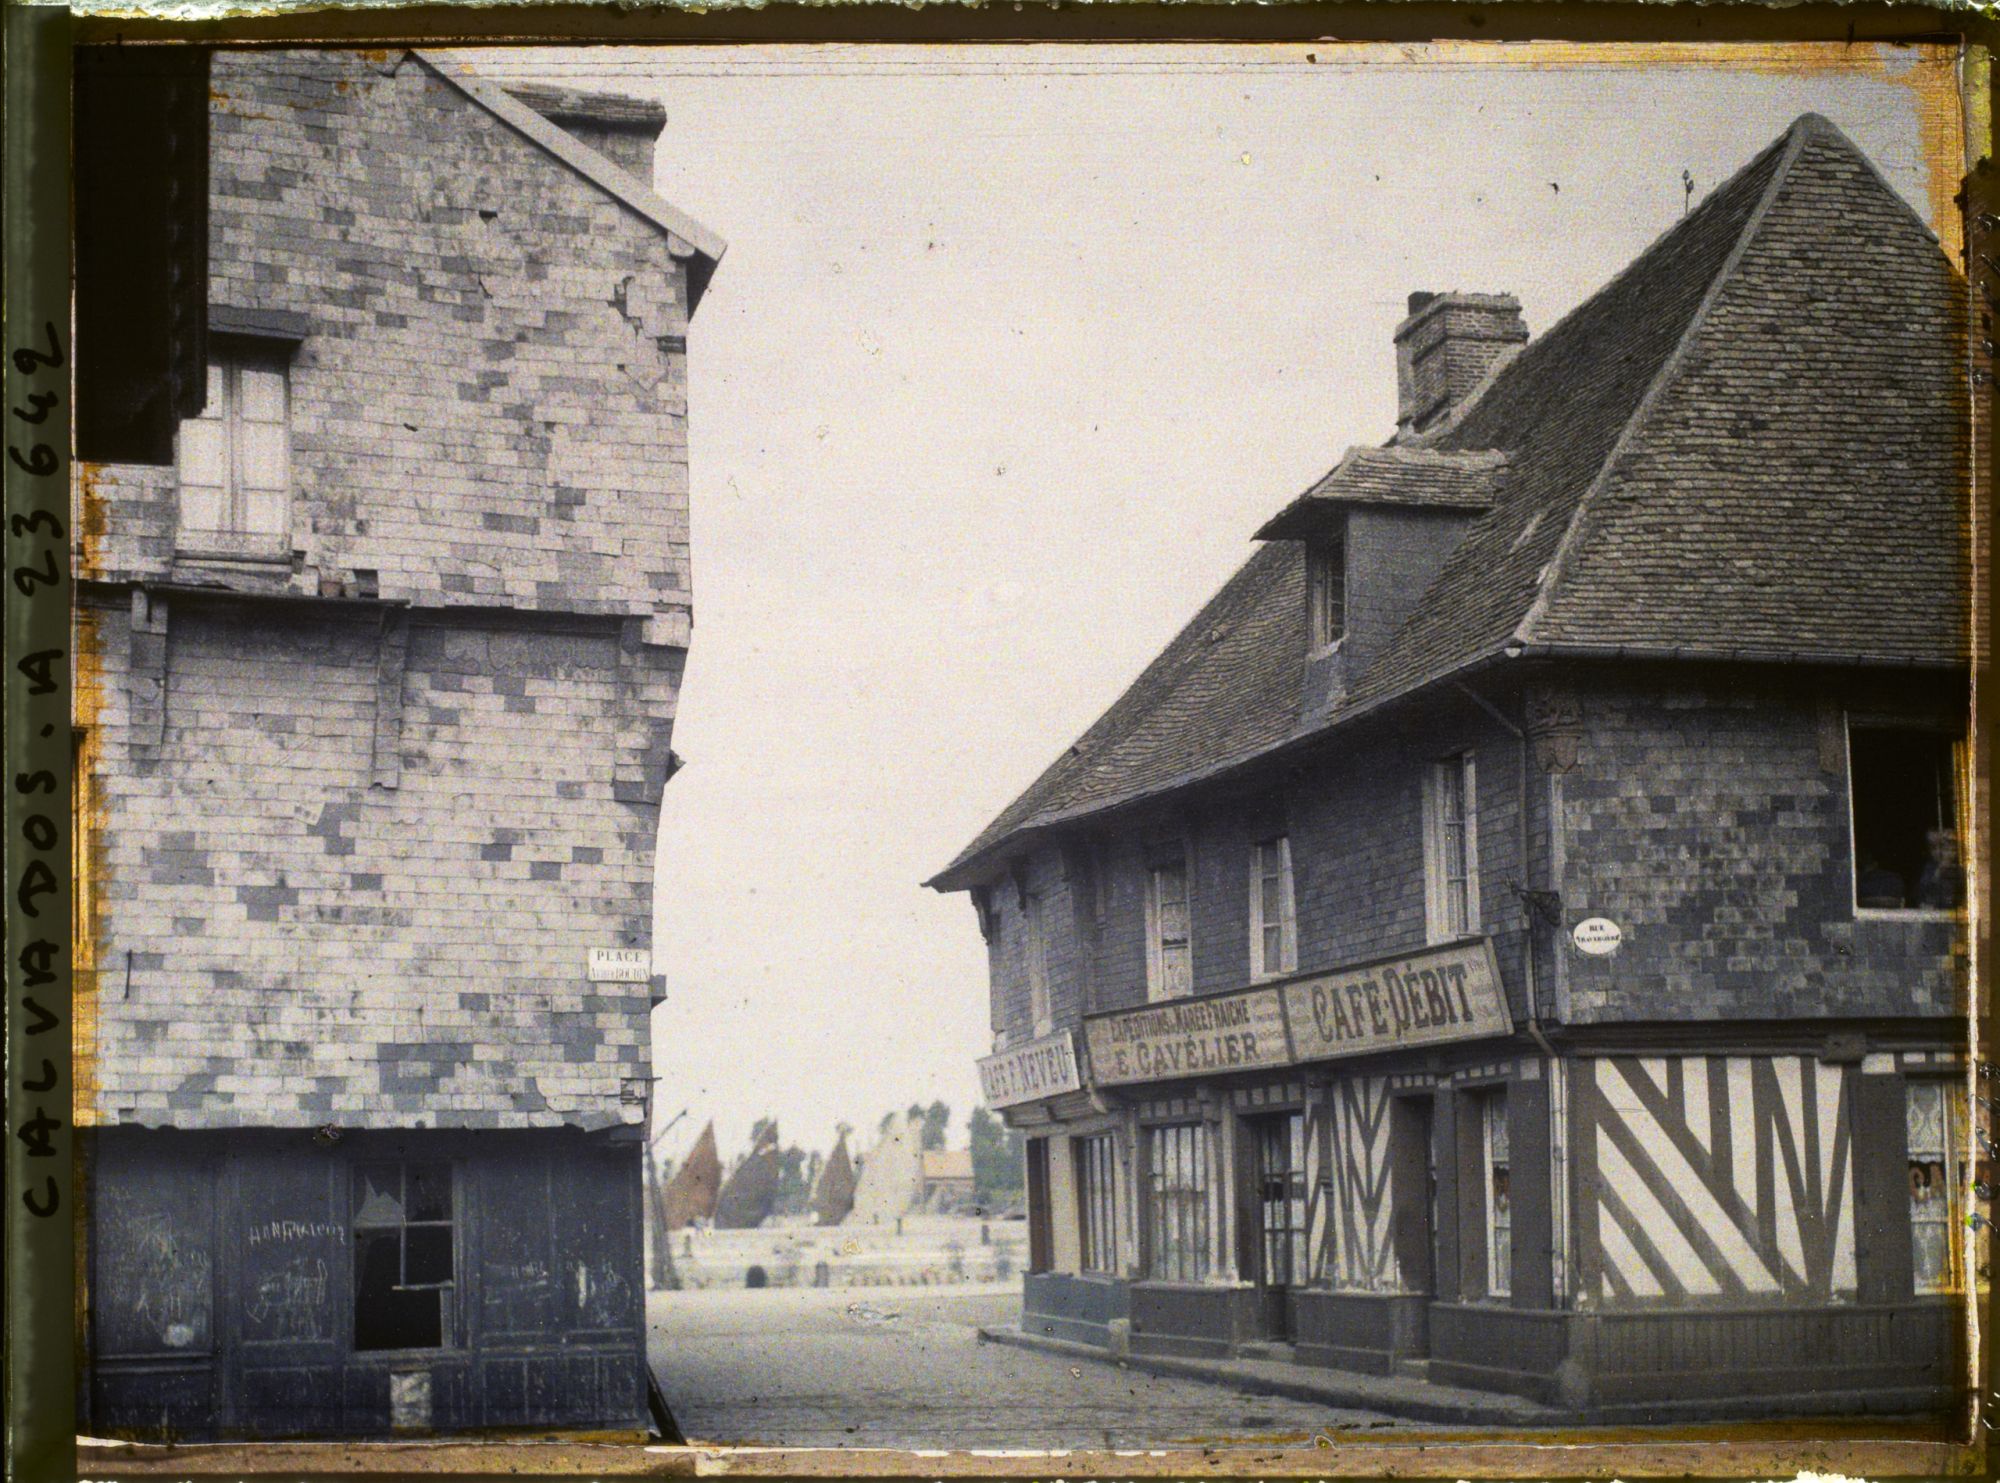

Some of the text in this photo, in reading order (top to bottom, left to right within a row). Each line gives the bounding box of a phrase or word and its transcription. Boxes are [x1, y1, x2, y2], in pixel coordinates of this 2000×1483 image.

[9, 320, 64, 612] 23642
[597, 949, 643, 963] PLACE
[1016, 1044, 1069, 1094] NEVEU
[1136, 1031, 1261, 1076] CAVÉLIER
